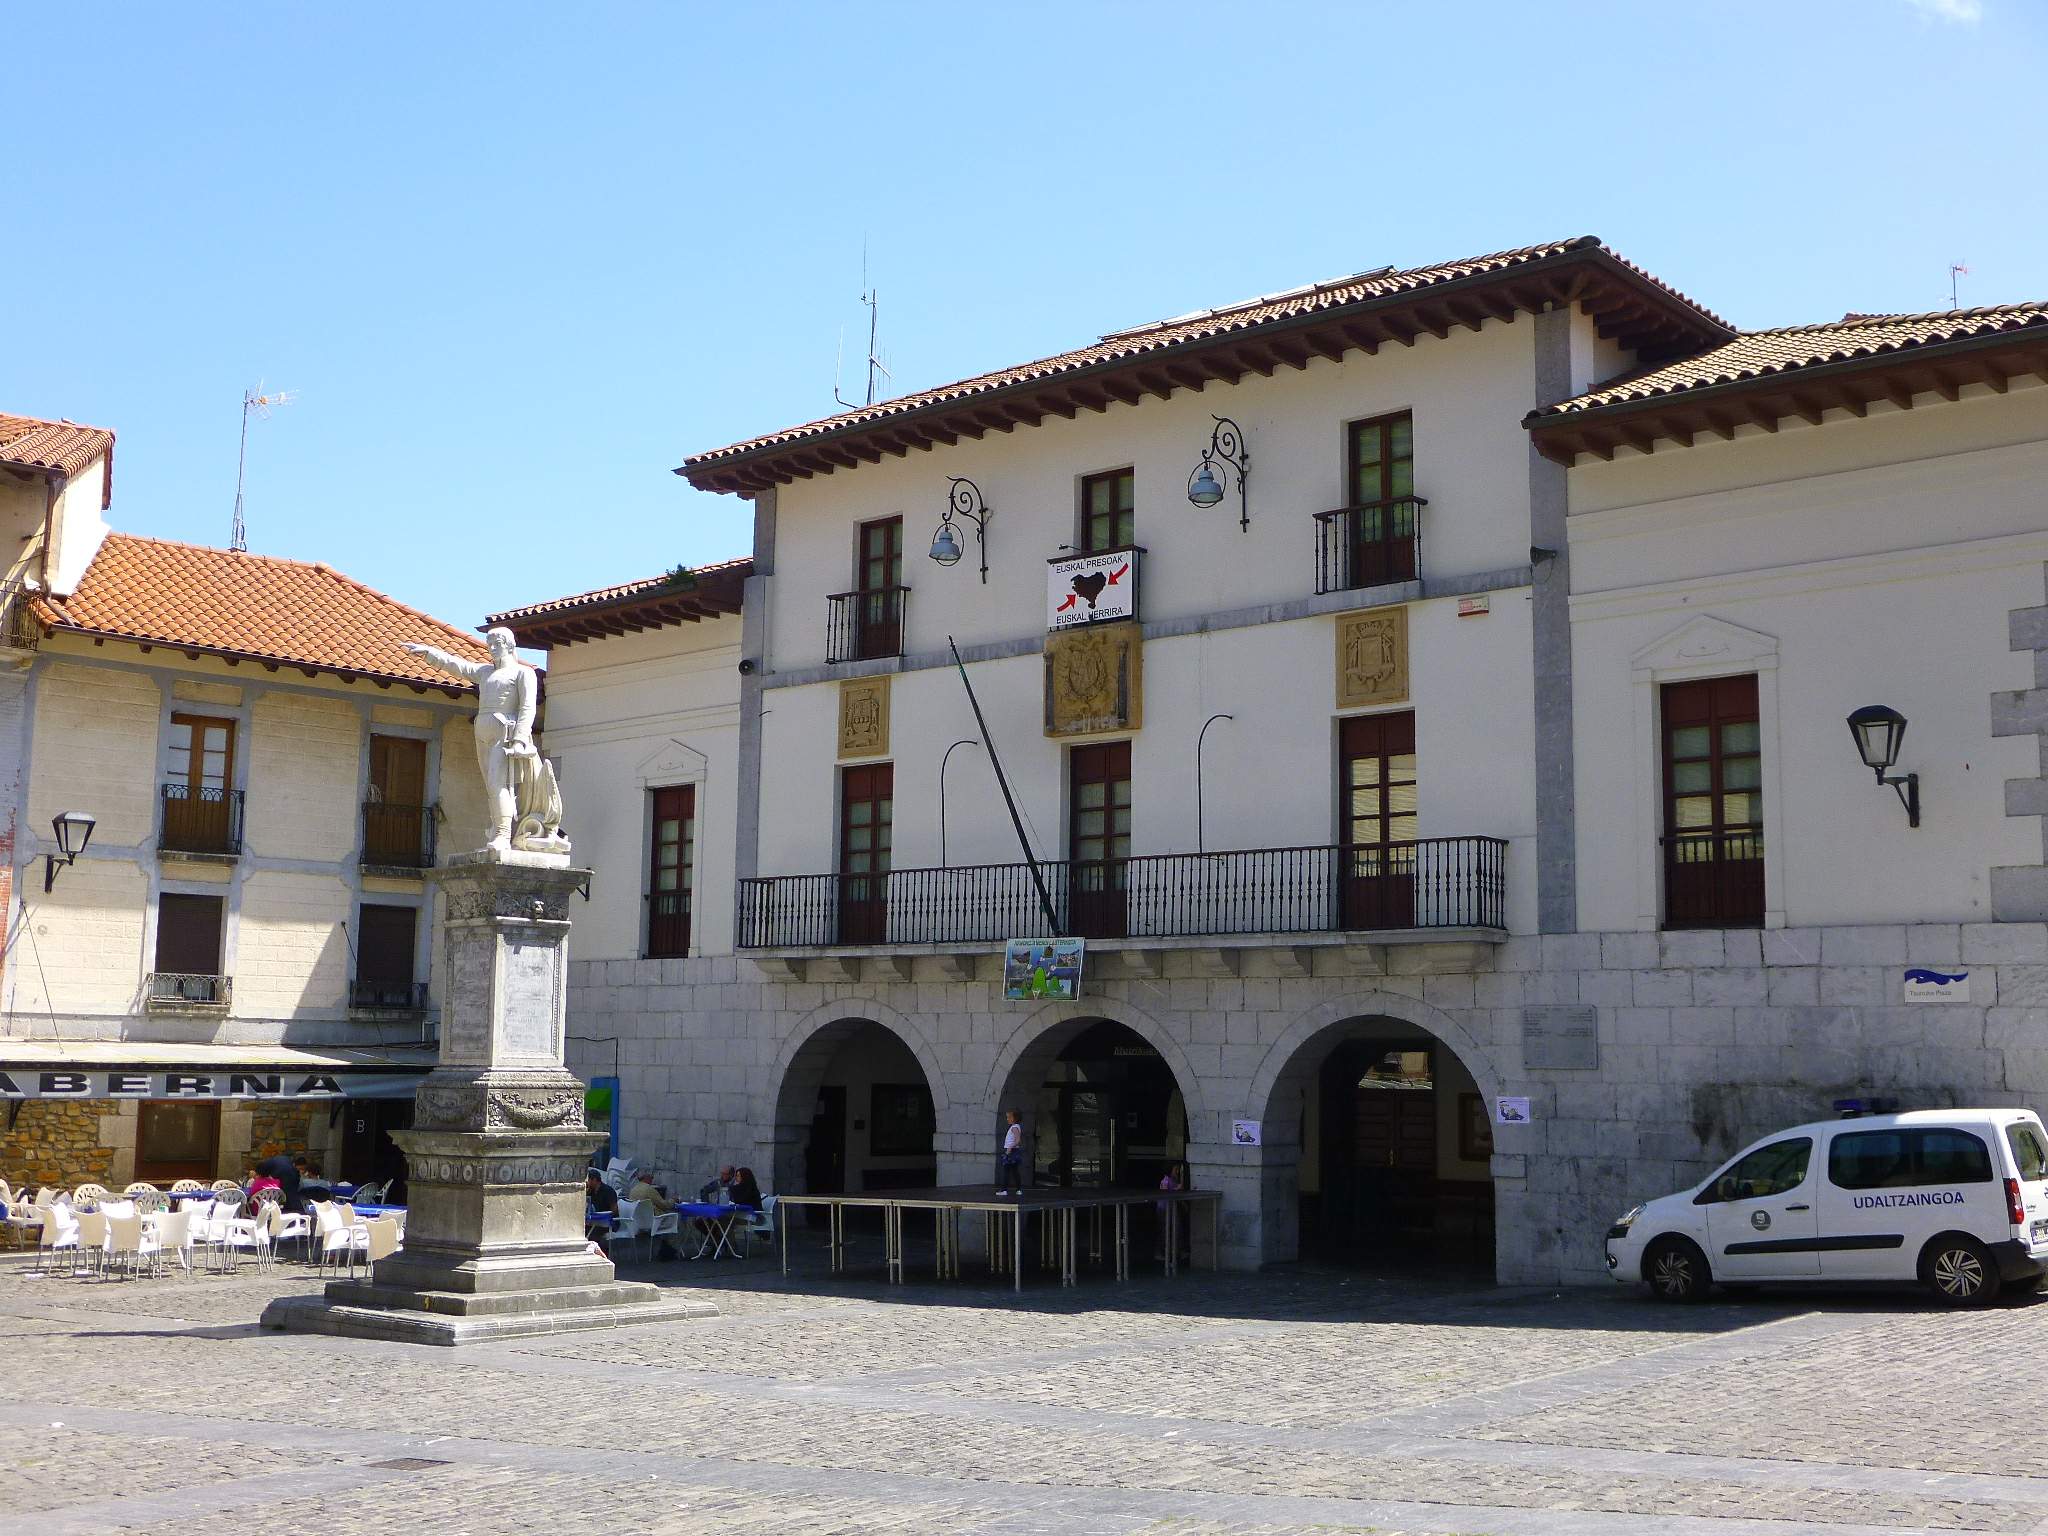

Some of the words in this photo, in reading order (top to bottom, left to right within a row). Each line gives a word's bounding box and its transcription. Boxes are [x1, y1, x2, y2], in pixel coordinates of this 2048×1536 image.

[1056, 561, 1085, 574] EUSKAL
[1086, 554, 1123, 569] PRESOAK
[1056, 613, 1086, 625] EUSKAL
[1088, 606, 1123, 619] HERRIRA
[1853, 1191, 1965, 1209] UDALTZAINGOA
